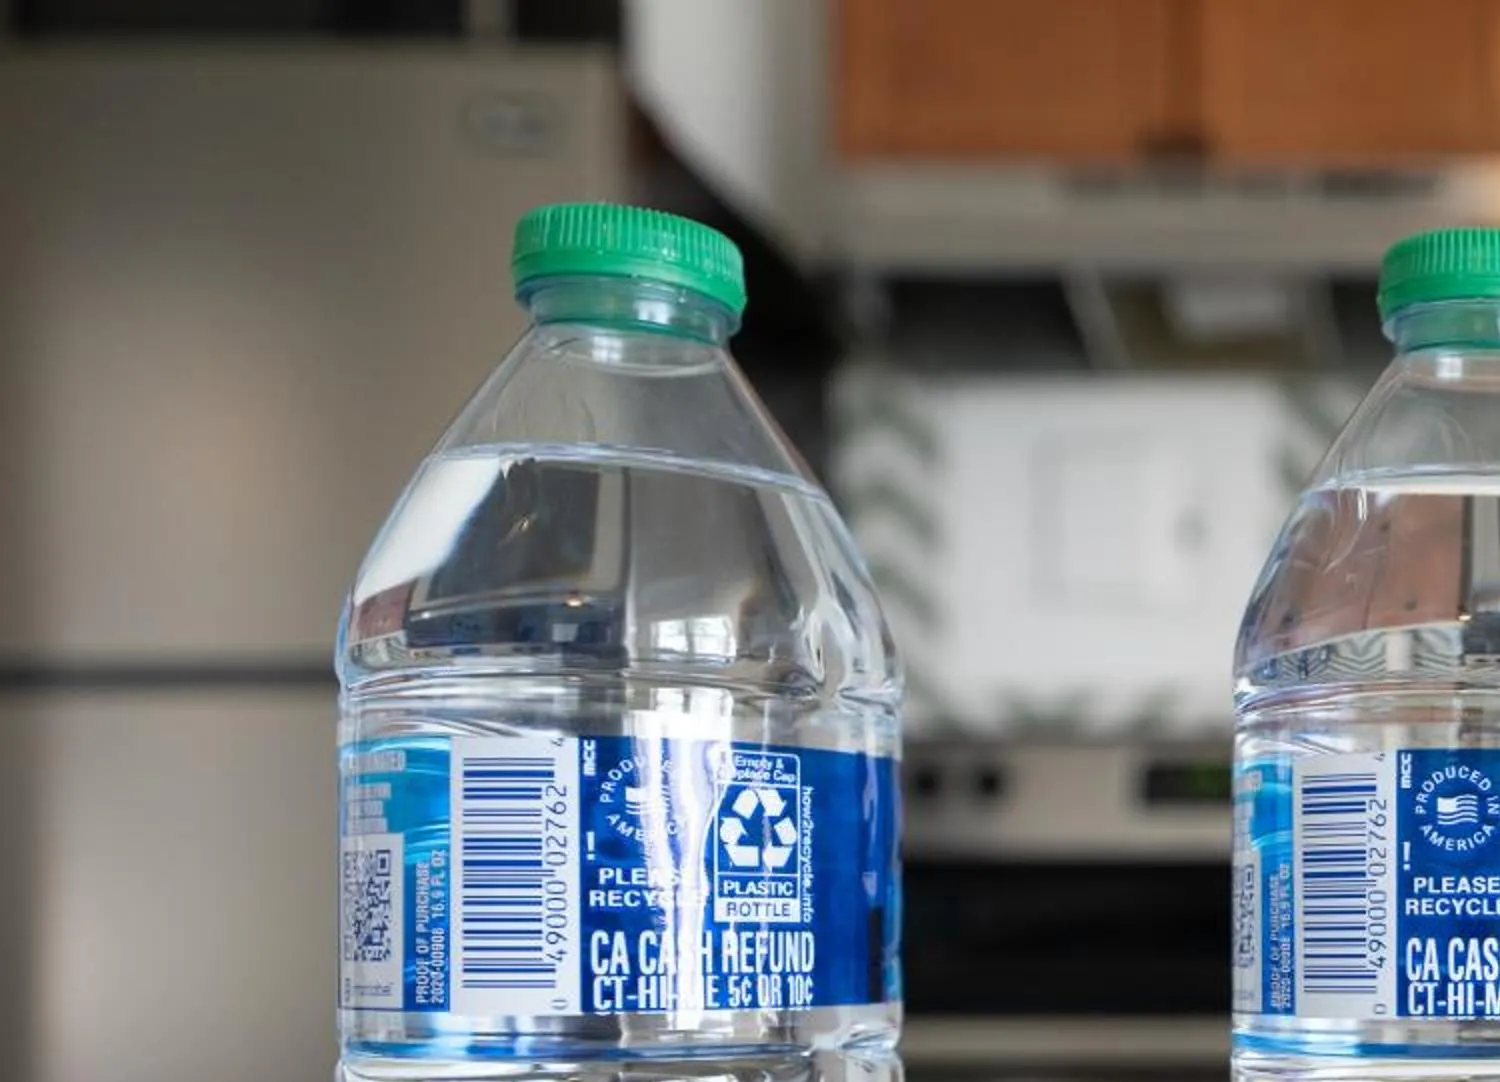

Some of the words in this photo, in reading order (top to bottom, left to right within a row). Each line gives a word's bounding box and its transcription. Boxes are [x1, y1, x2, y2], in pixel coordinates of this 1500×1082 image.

[1414, 765, 1492, 815] PRODUCED
[1486, 794, 1500, 815] IN
[545, 784, 568, 867] 02762
[1367, 799, 1387, 877] 02762
[1419, 823, 1496, 852] AMERICA
[431, 850, 446, 867] OZ
[801, 785, 815, 924] how2recycle.info
[415, 860, 429, 933] PURCHASE
[431, 869, 445, 888] FL
[723, 879, 794, 897] PLASTIC
[431, 889, 445, 919] 16.9
[545, 880, 568, 963] 49000
[726, 901, 792, 917] BOTTLE
[415, 936, 429, 955] OF
[1367, 889, 1387, 969] 49000
[590, 928, 631, 975] CA
[638, 928, 713, 975] CAH
[722, 929, 815, 974] REFUND
[1405, 937, 1440, 981] CA
[415, 957, 429, 1004] PROOF
[592, 975, 720, 1010] CT-HI-E
[727, 974, 752, 1008] 5¢
[757, 973, 782, 1008] OR
[787, 974, 814, 1007] 10¢
[552, 998, 569, 1011] 0
